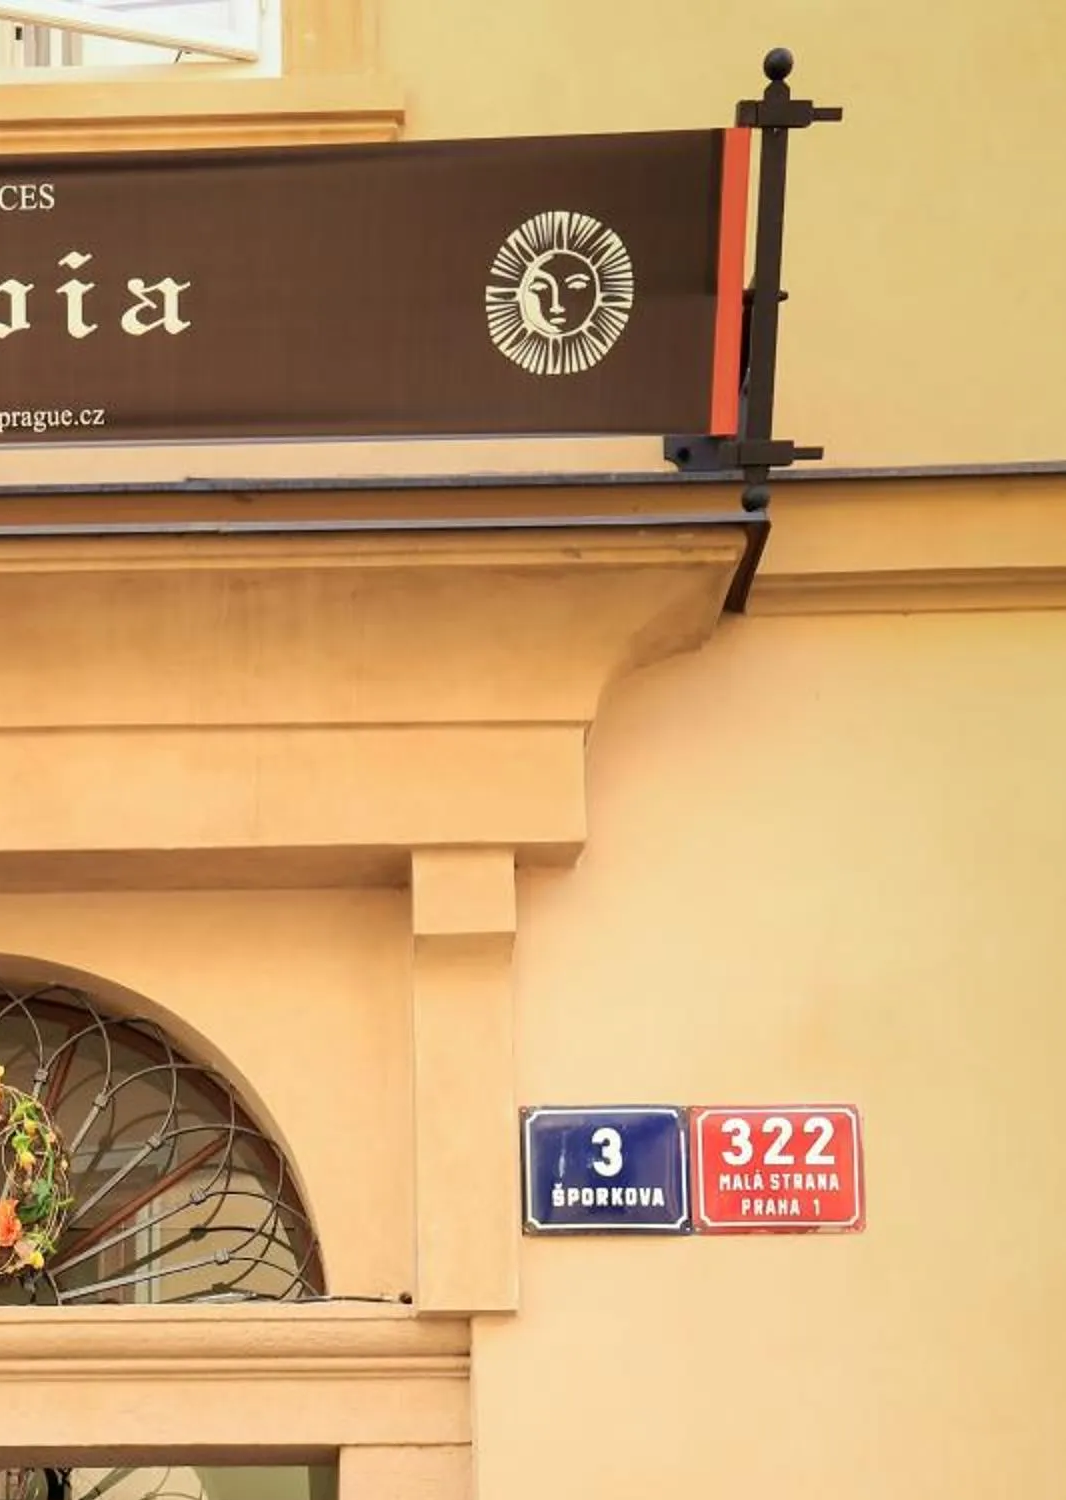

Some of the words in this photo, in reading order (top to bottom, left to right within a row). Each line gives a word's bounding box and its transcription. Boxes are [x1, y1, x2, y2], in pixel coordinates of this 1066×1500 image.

[591, 1127, 623, 1177] 3
[721, 1117, 835, 1165] 322
[719, 1170, 764, 1191] MALÁ
[769, 1173, 839, 1190] STRANA
[551, 1183, 665, 1207] ŠPORKOVA
[742, 1198, 800, 1216] PRAHA
[812, 1198, 821, 1215] 1
